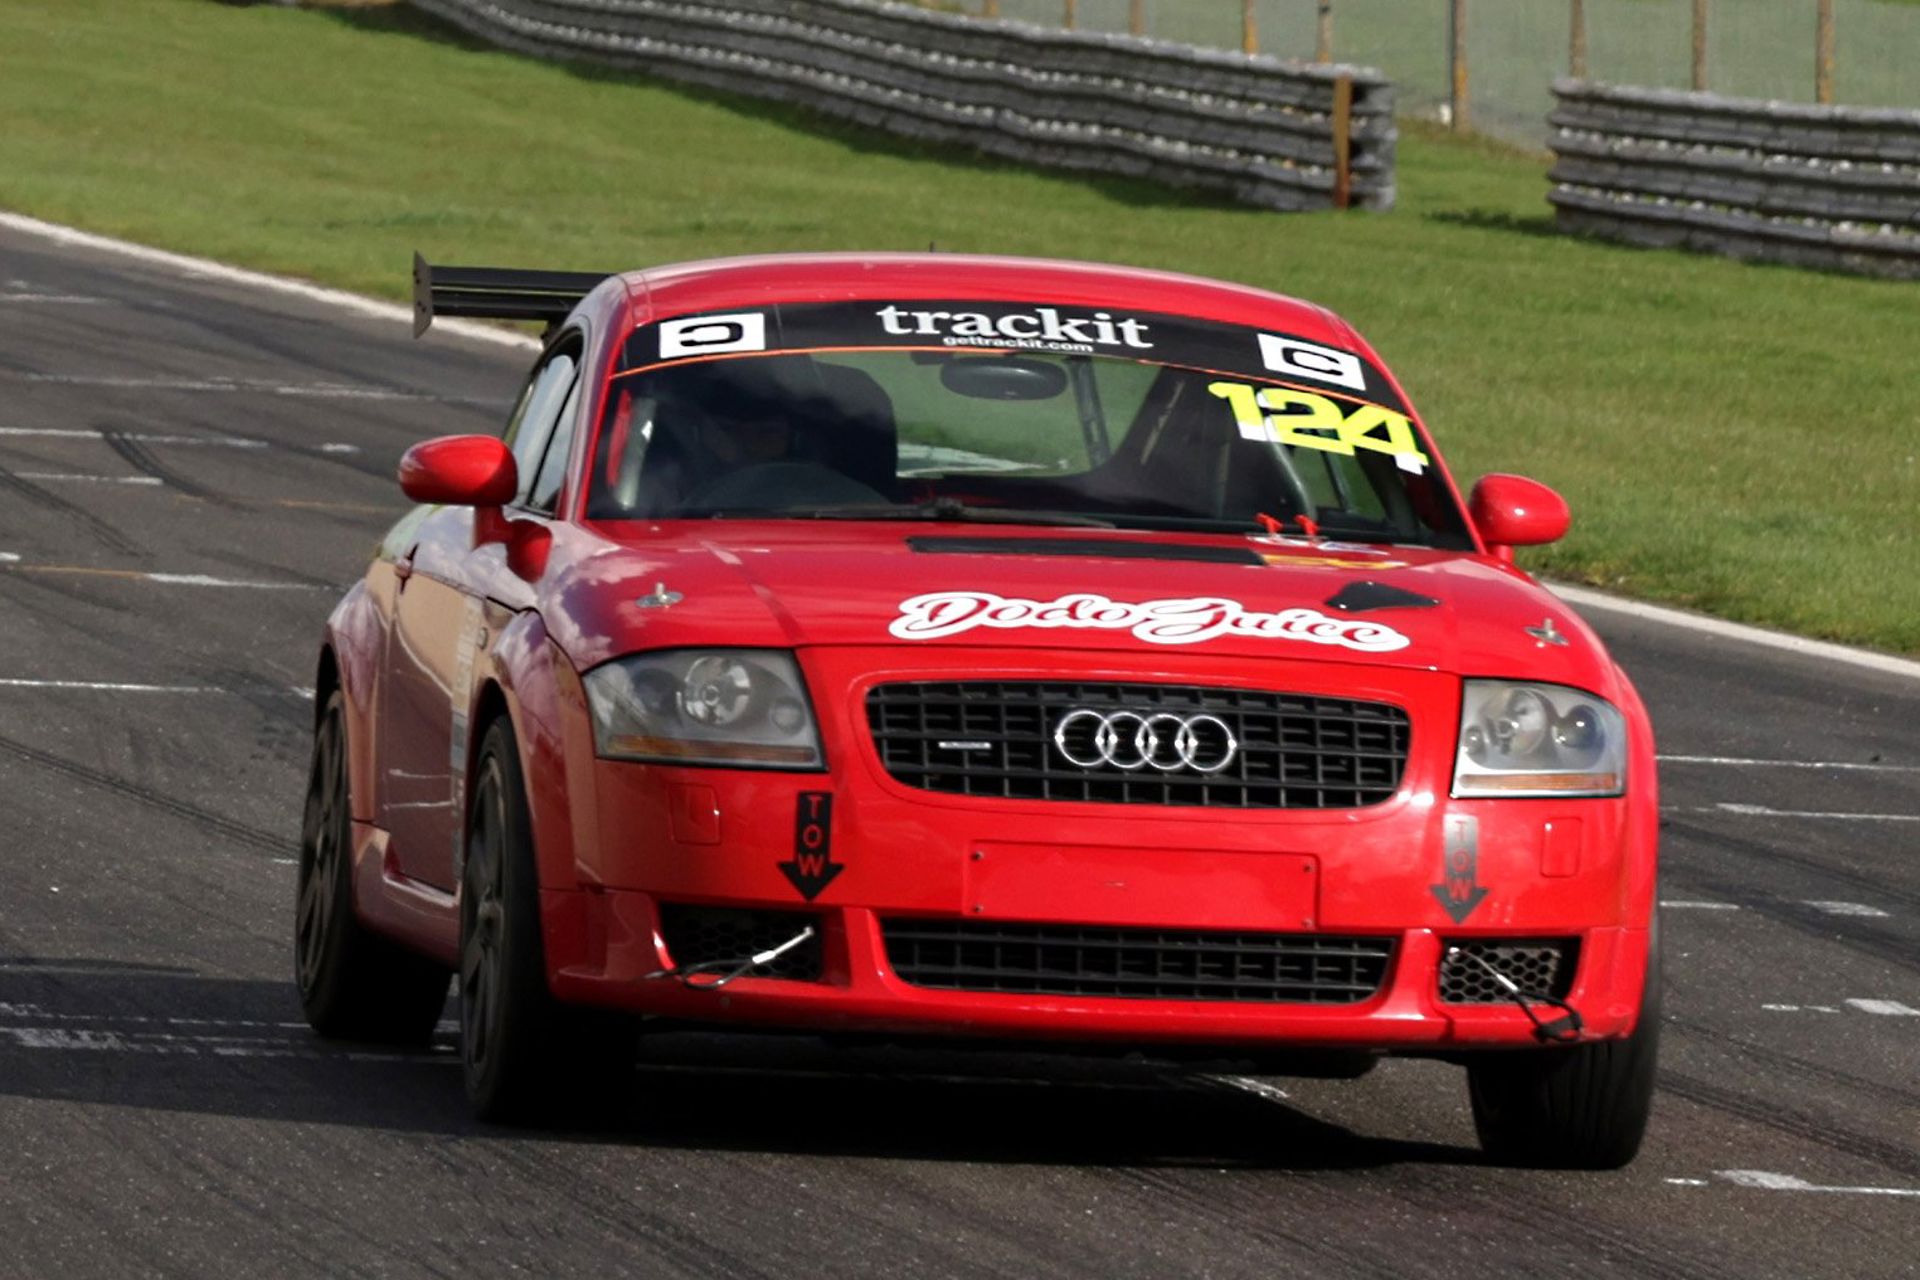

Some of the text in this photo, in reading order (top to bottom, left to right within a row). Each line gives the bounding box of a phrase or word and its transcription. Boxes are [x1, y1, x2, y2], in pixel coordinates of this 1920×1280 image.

[875, 305, 1153, 348] trackit
[943, 336, 1094, 352] gettrackit.com
[1208, 381, 1429, 476] 124
[798, 794, 824, 877] TOW
[1446, 819, 1474, 902] TOW
